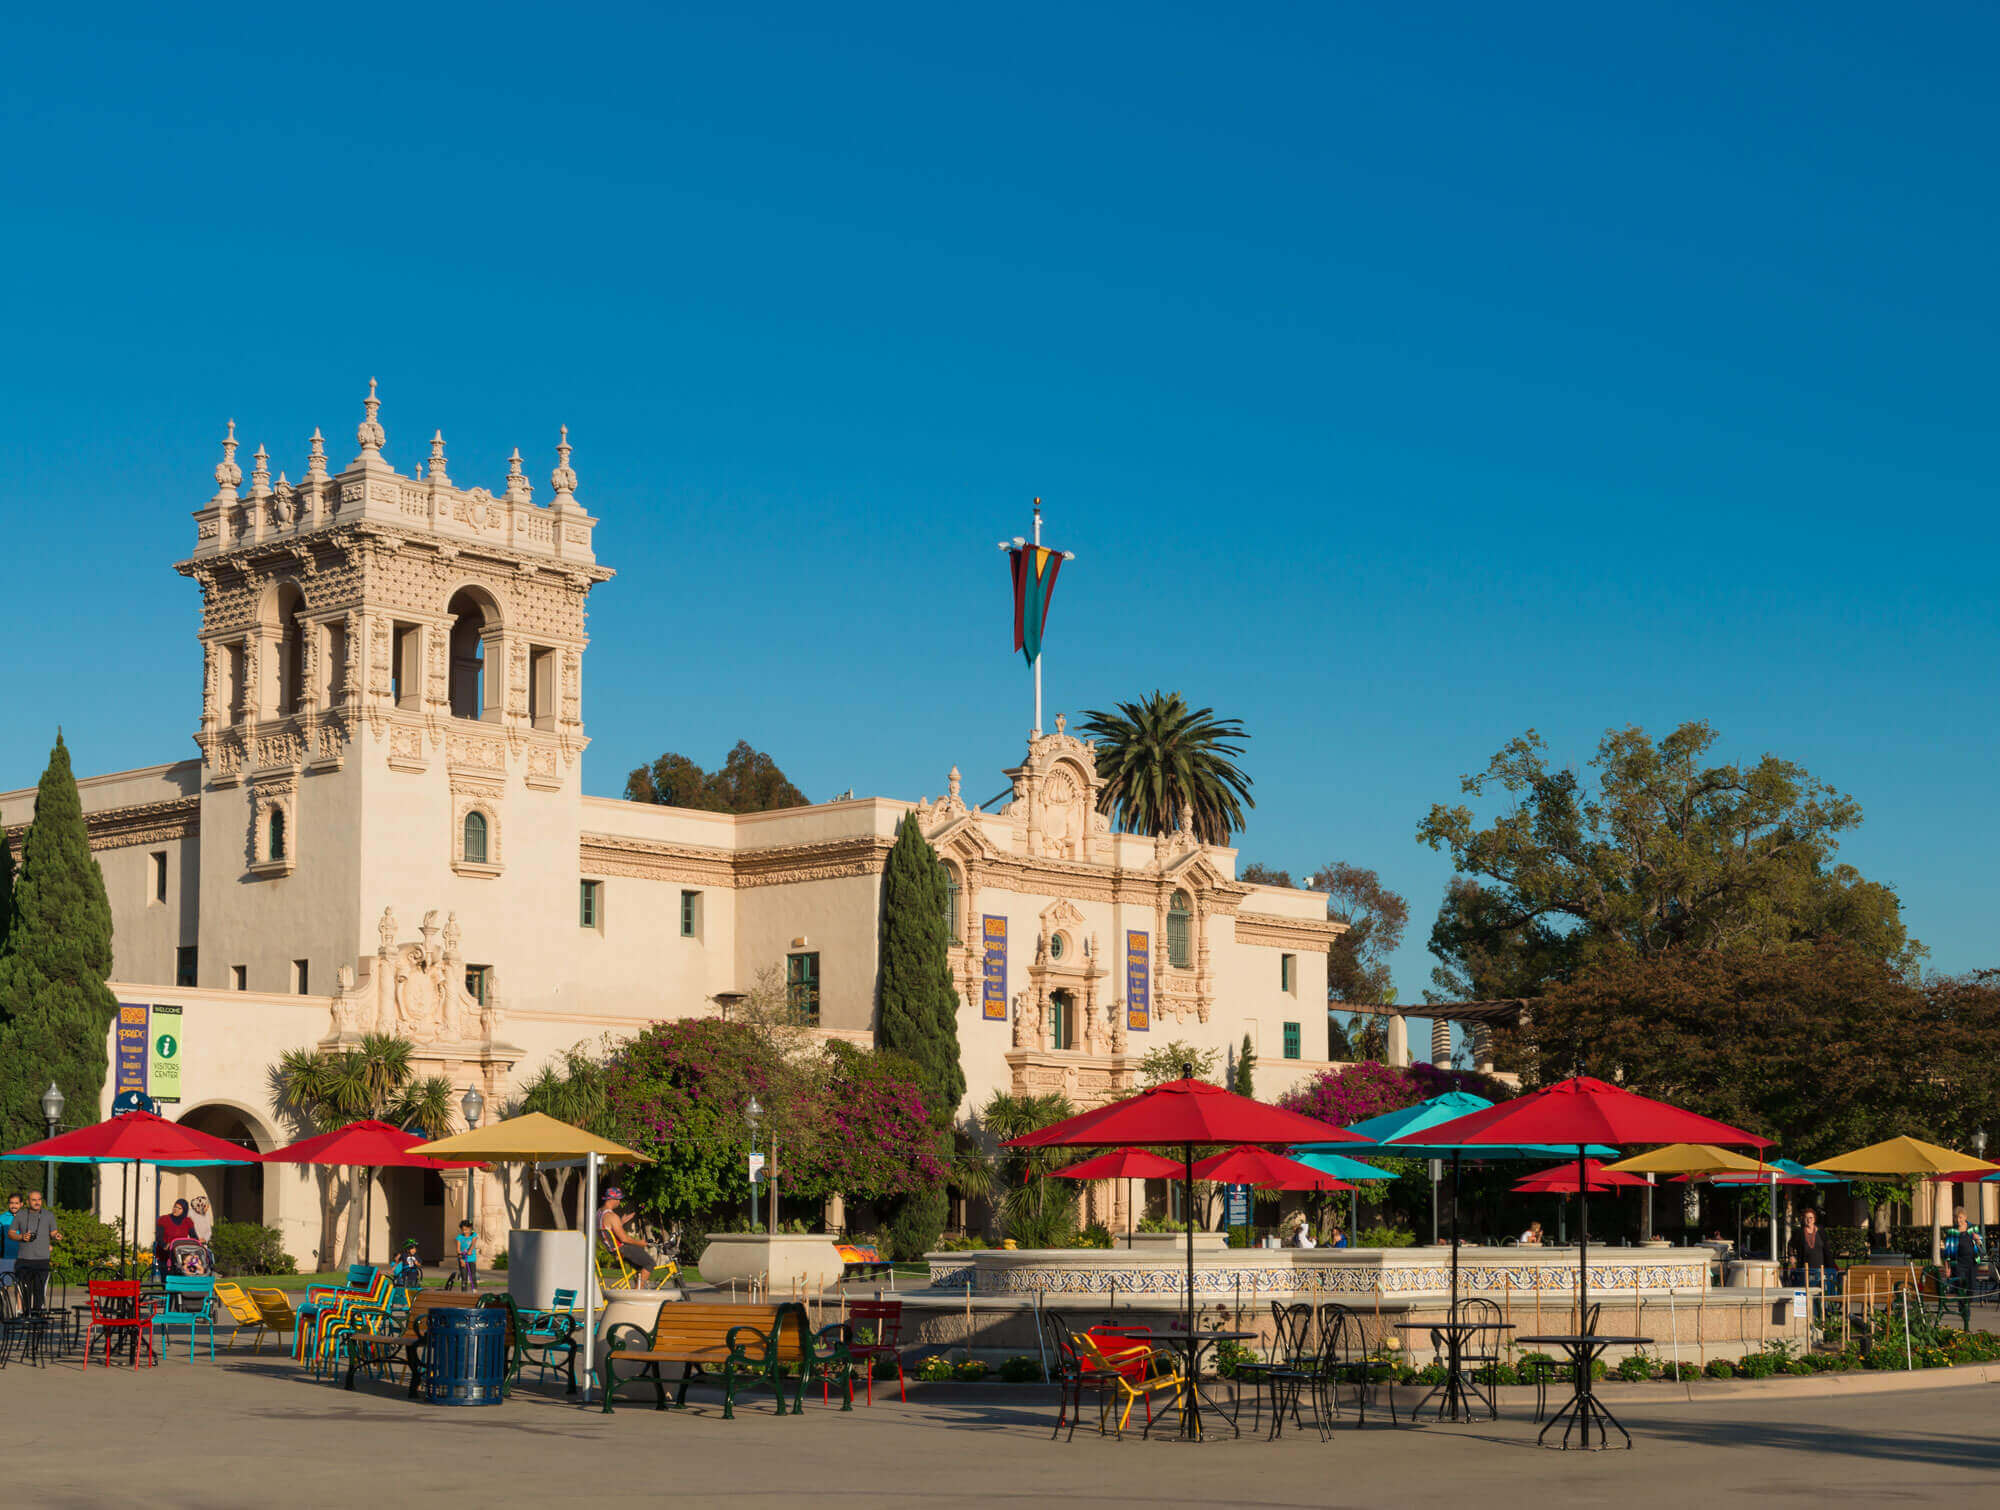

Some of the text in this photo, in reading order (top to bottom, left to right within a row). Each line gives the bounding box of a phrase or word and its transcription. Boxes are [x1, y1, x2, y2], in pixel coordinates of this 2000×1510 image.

[154, 1006, 180, 1014] WELCOME
[153, 1062, 180, 1071] VISITORS
[154, 1070, 178, 1079] CENTER
